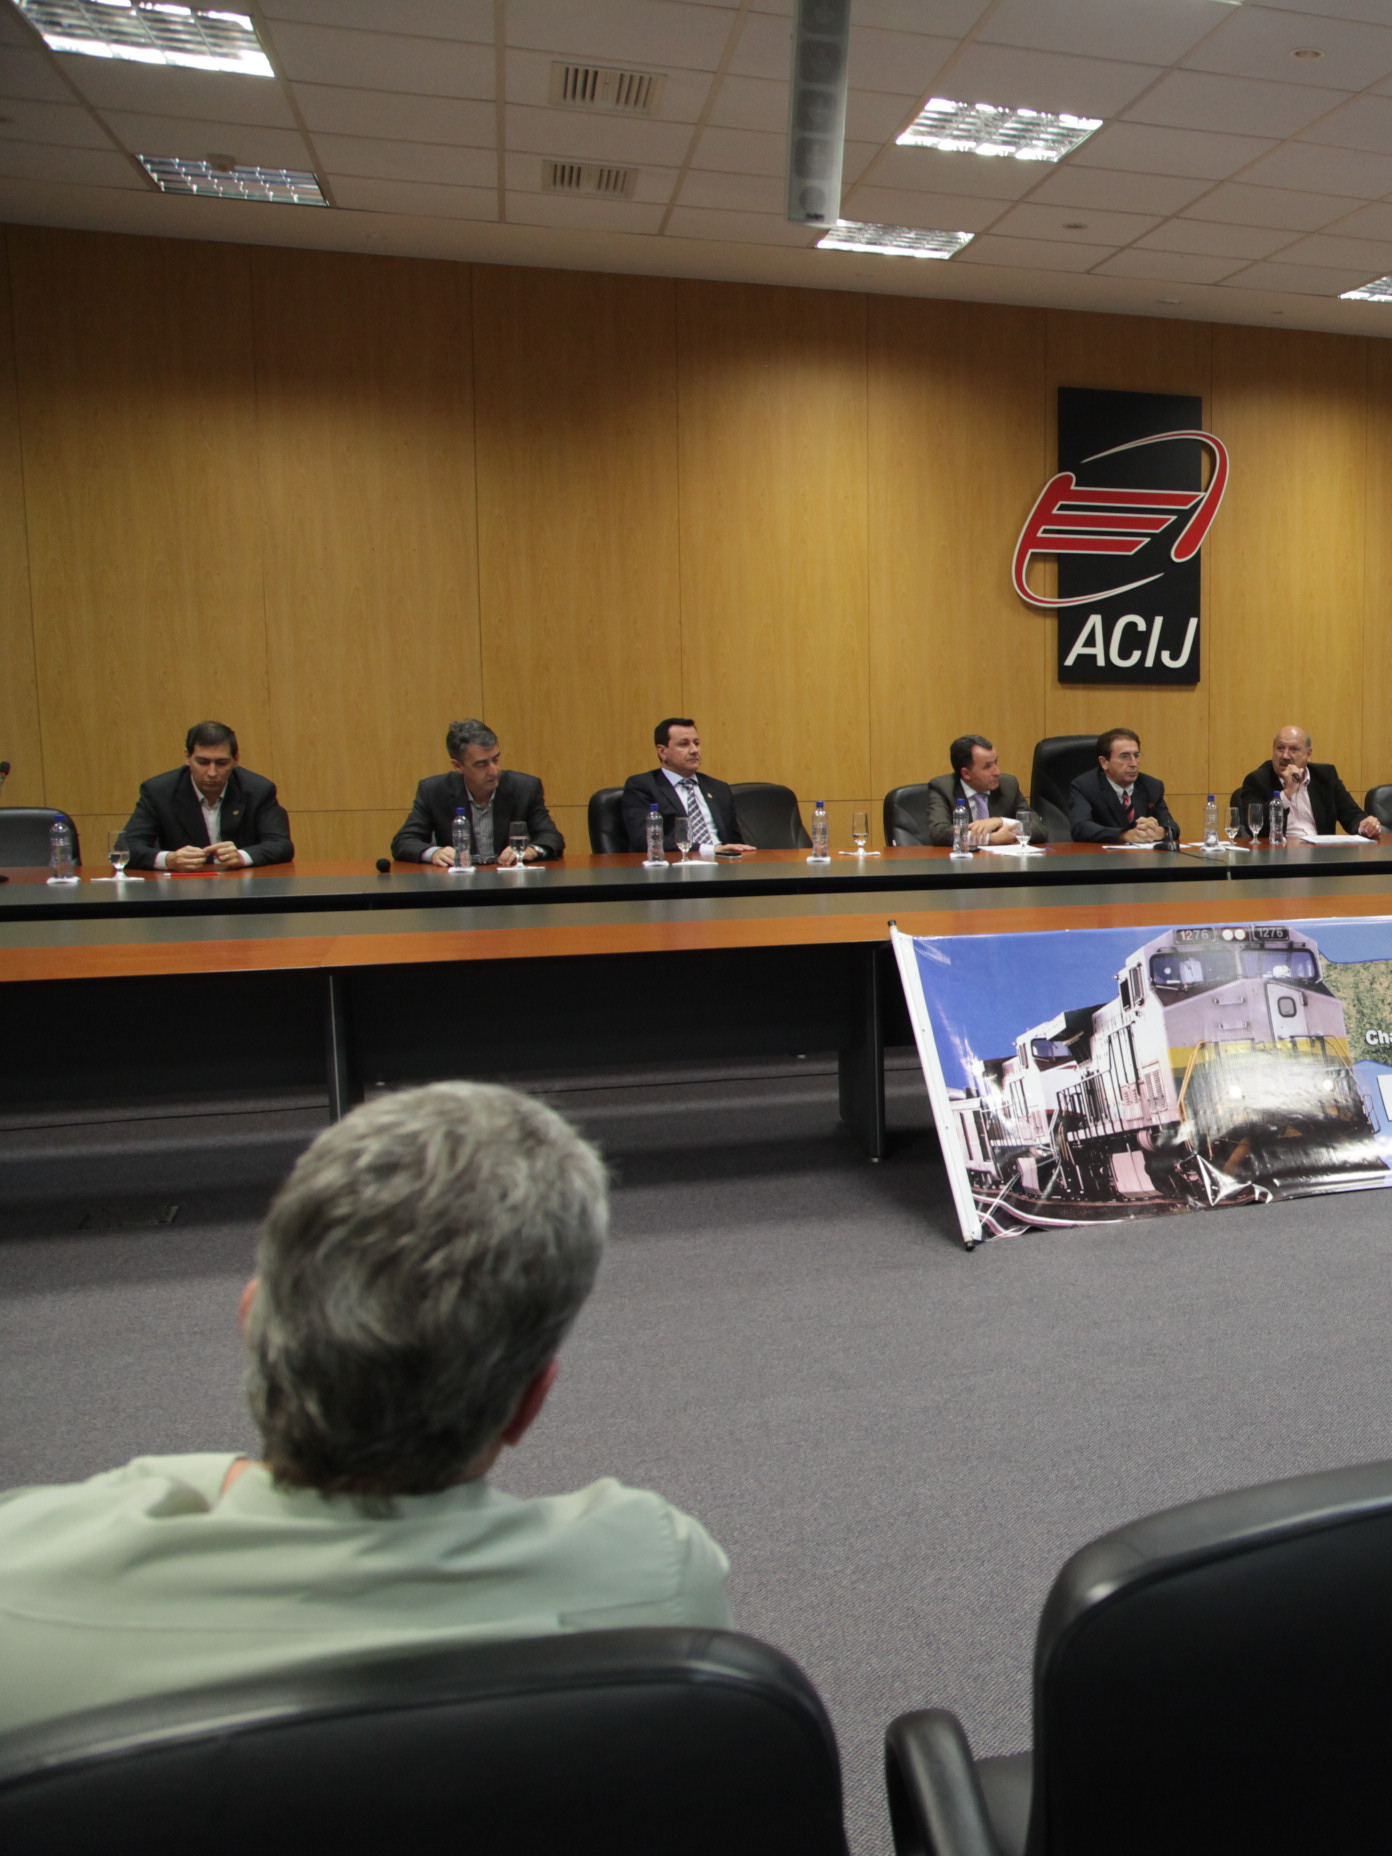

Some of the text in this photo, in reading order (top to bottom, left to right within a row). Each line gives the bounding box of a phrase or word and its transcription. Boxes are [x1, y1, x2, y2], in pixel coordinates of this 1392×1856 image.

[1063, 614, 1198, 669] ACIJ
[1179, 928, 1210, 941] 1276
[1258, 926, 1285, 938] 1276
